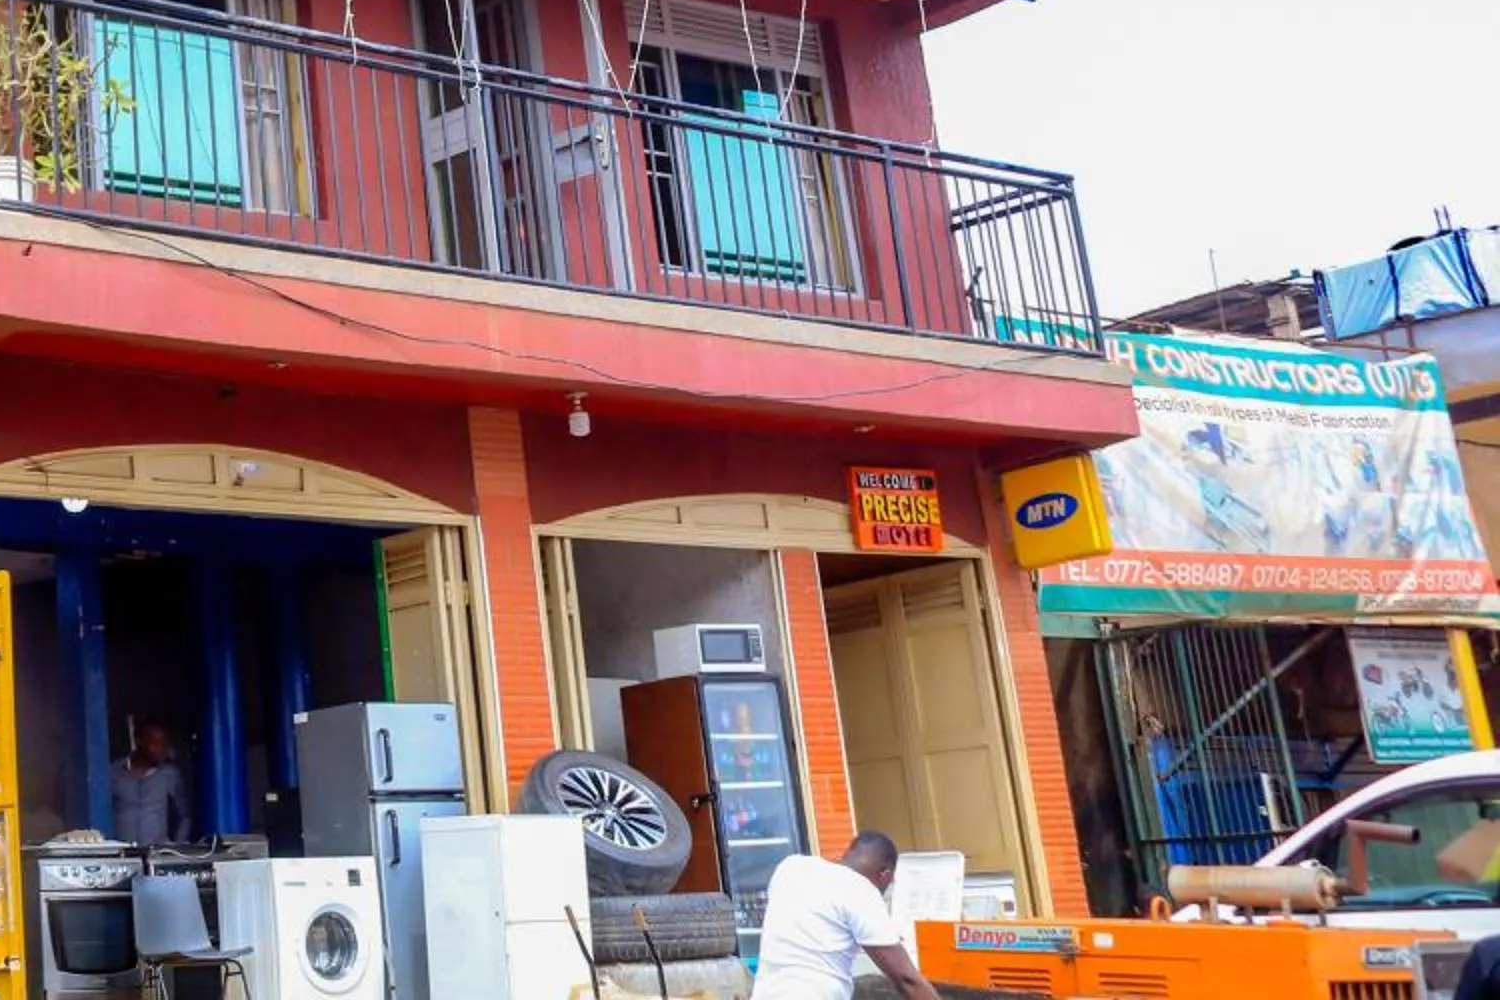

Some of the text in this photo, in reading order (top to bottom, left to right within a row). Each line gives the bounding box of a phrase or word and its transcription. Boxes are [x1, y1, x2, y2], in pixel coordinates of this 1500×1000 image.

[1145, 344, 1366, 395] CONSTRUCTORS
[858, 472, 917, 491] WELCOME
[860, 493, 941, 525] PRECISE
[1027, 497, 1066, 525] MTN
[1059, 559, 1100, 582] TEL:
[958, 926, 1017, 948] Denyo
